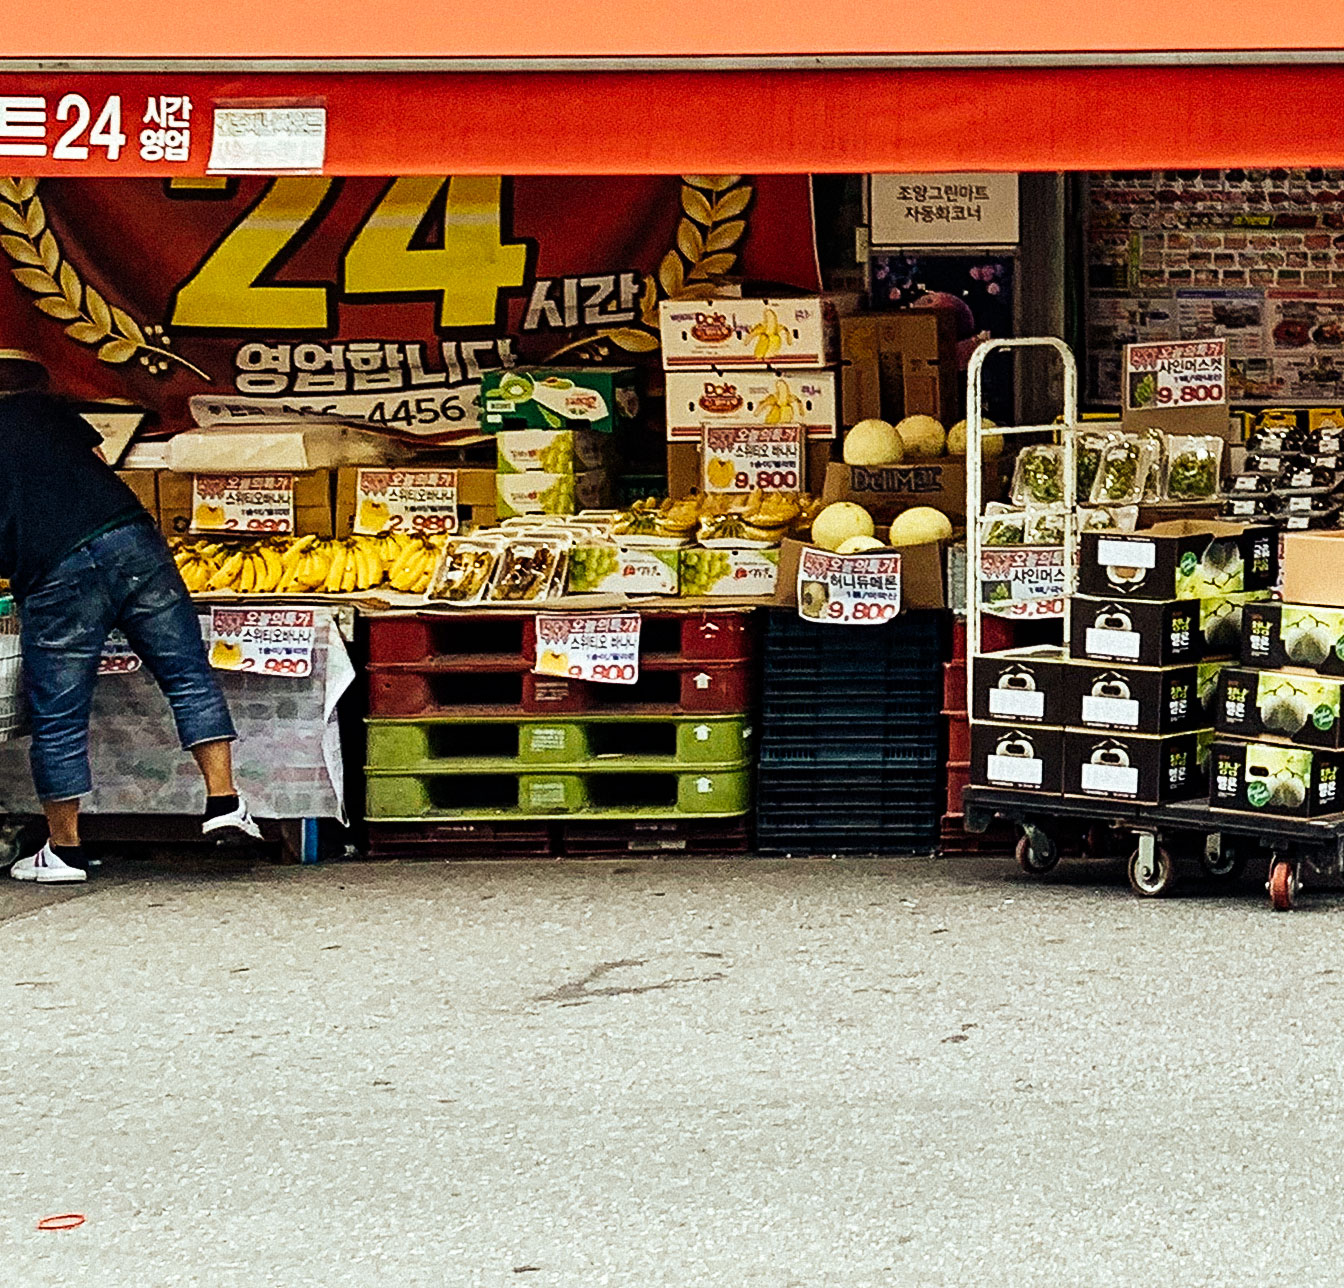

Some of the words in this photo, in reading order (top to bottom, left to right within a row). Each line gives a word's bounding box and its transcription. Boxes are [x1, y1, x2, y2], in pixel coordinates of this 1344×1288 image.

[143, 95, 192, 128] 시간
[140, 129, 190, 161] 영업
[897, 184, 990, 201] 조양그린마트
[905, 205, 982, 222] 자동화코너
[170, 176, 526, 328] 24
[525, 273, 638, 331] 시간
[695, 311, 726, 325] Dole
[704, 382, 736, 395] Dole
[225, 518, 290, 531] 2980
[241, 658, 309, 673] 2980
[568, 664, 635, 680] 9800
